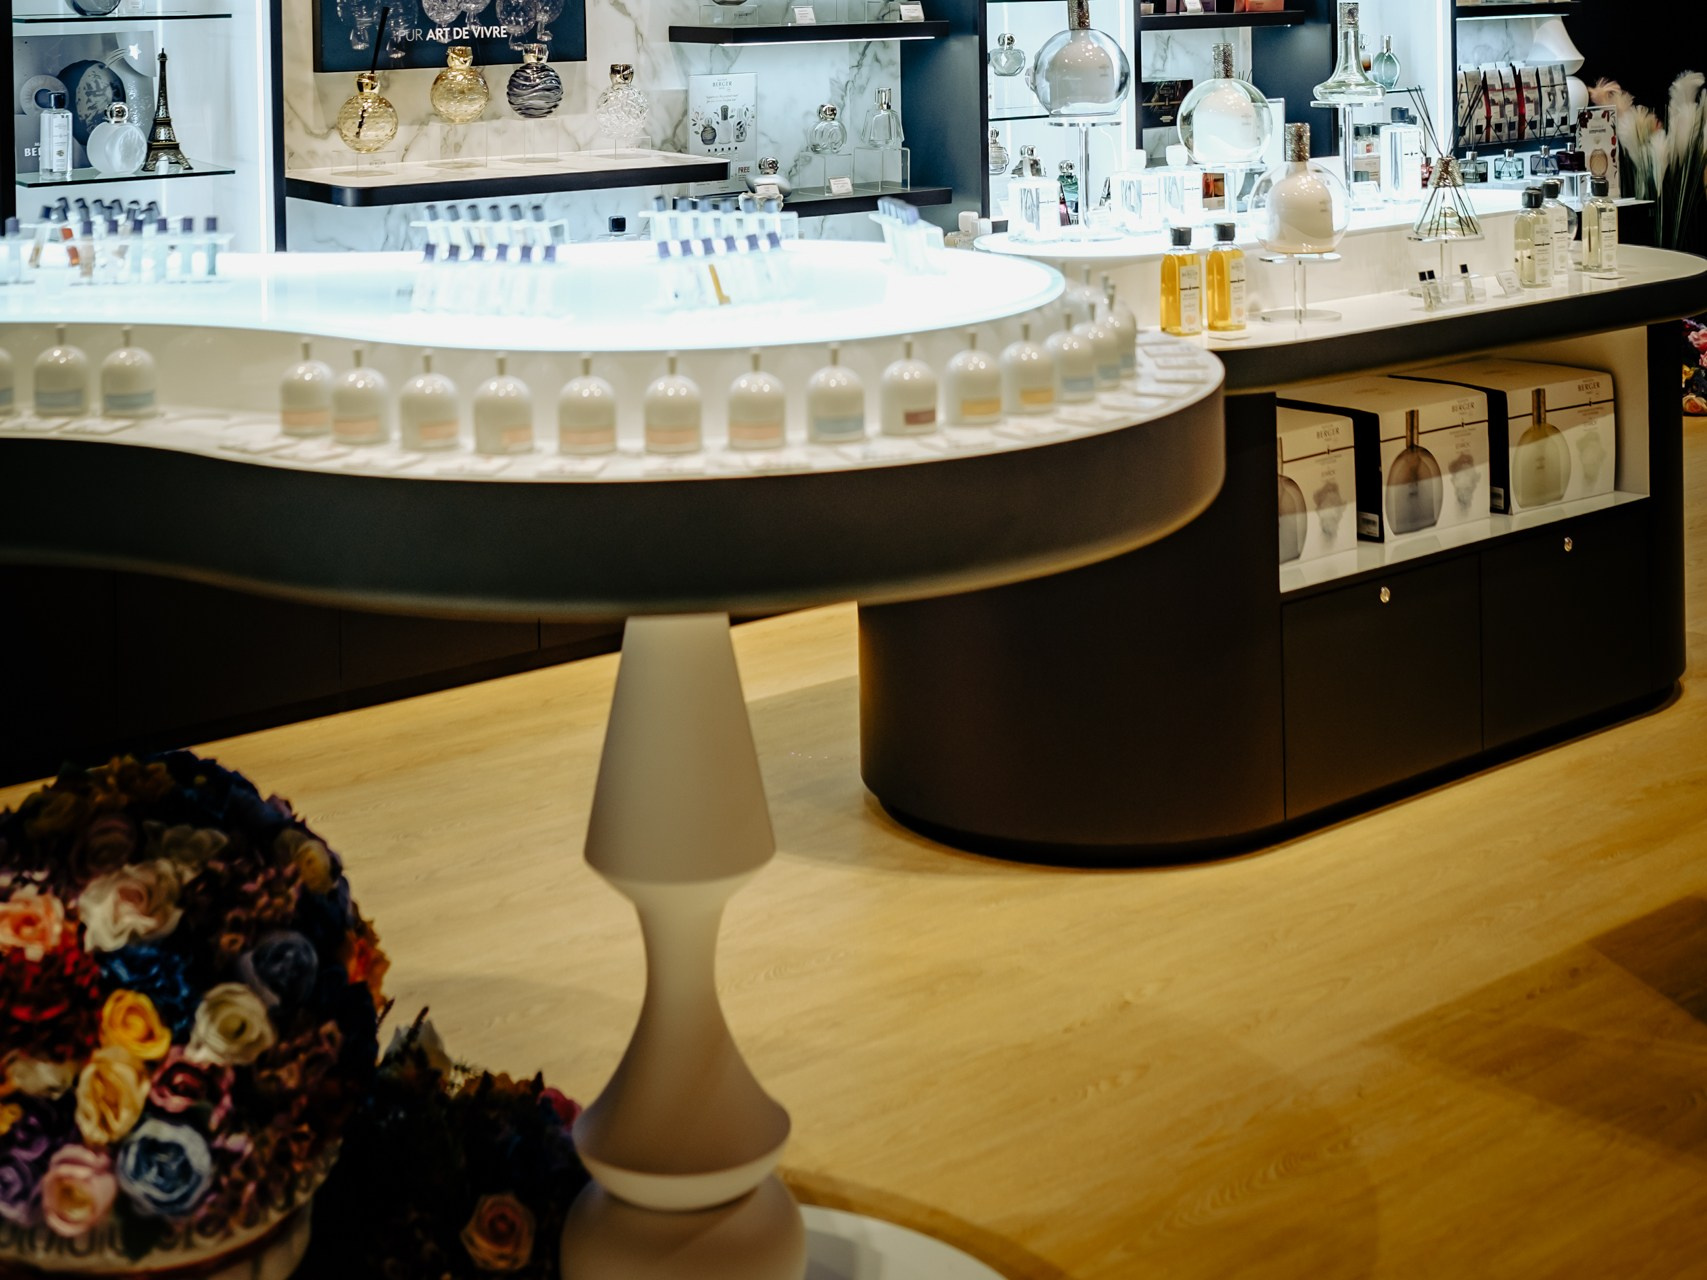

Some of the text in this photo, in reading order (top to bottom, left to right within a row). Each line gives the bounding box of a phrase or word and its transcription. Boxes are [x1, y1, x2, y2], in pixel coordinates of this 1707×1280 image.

[398, 25, 508, 42] PUR ART DE VIVRE
[1577, 381, 1601, 392] BERGER
